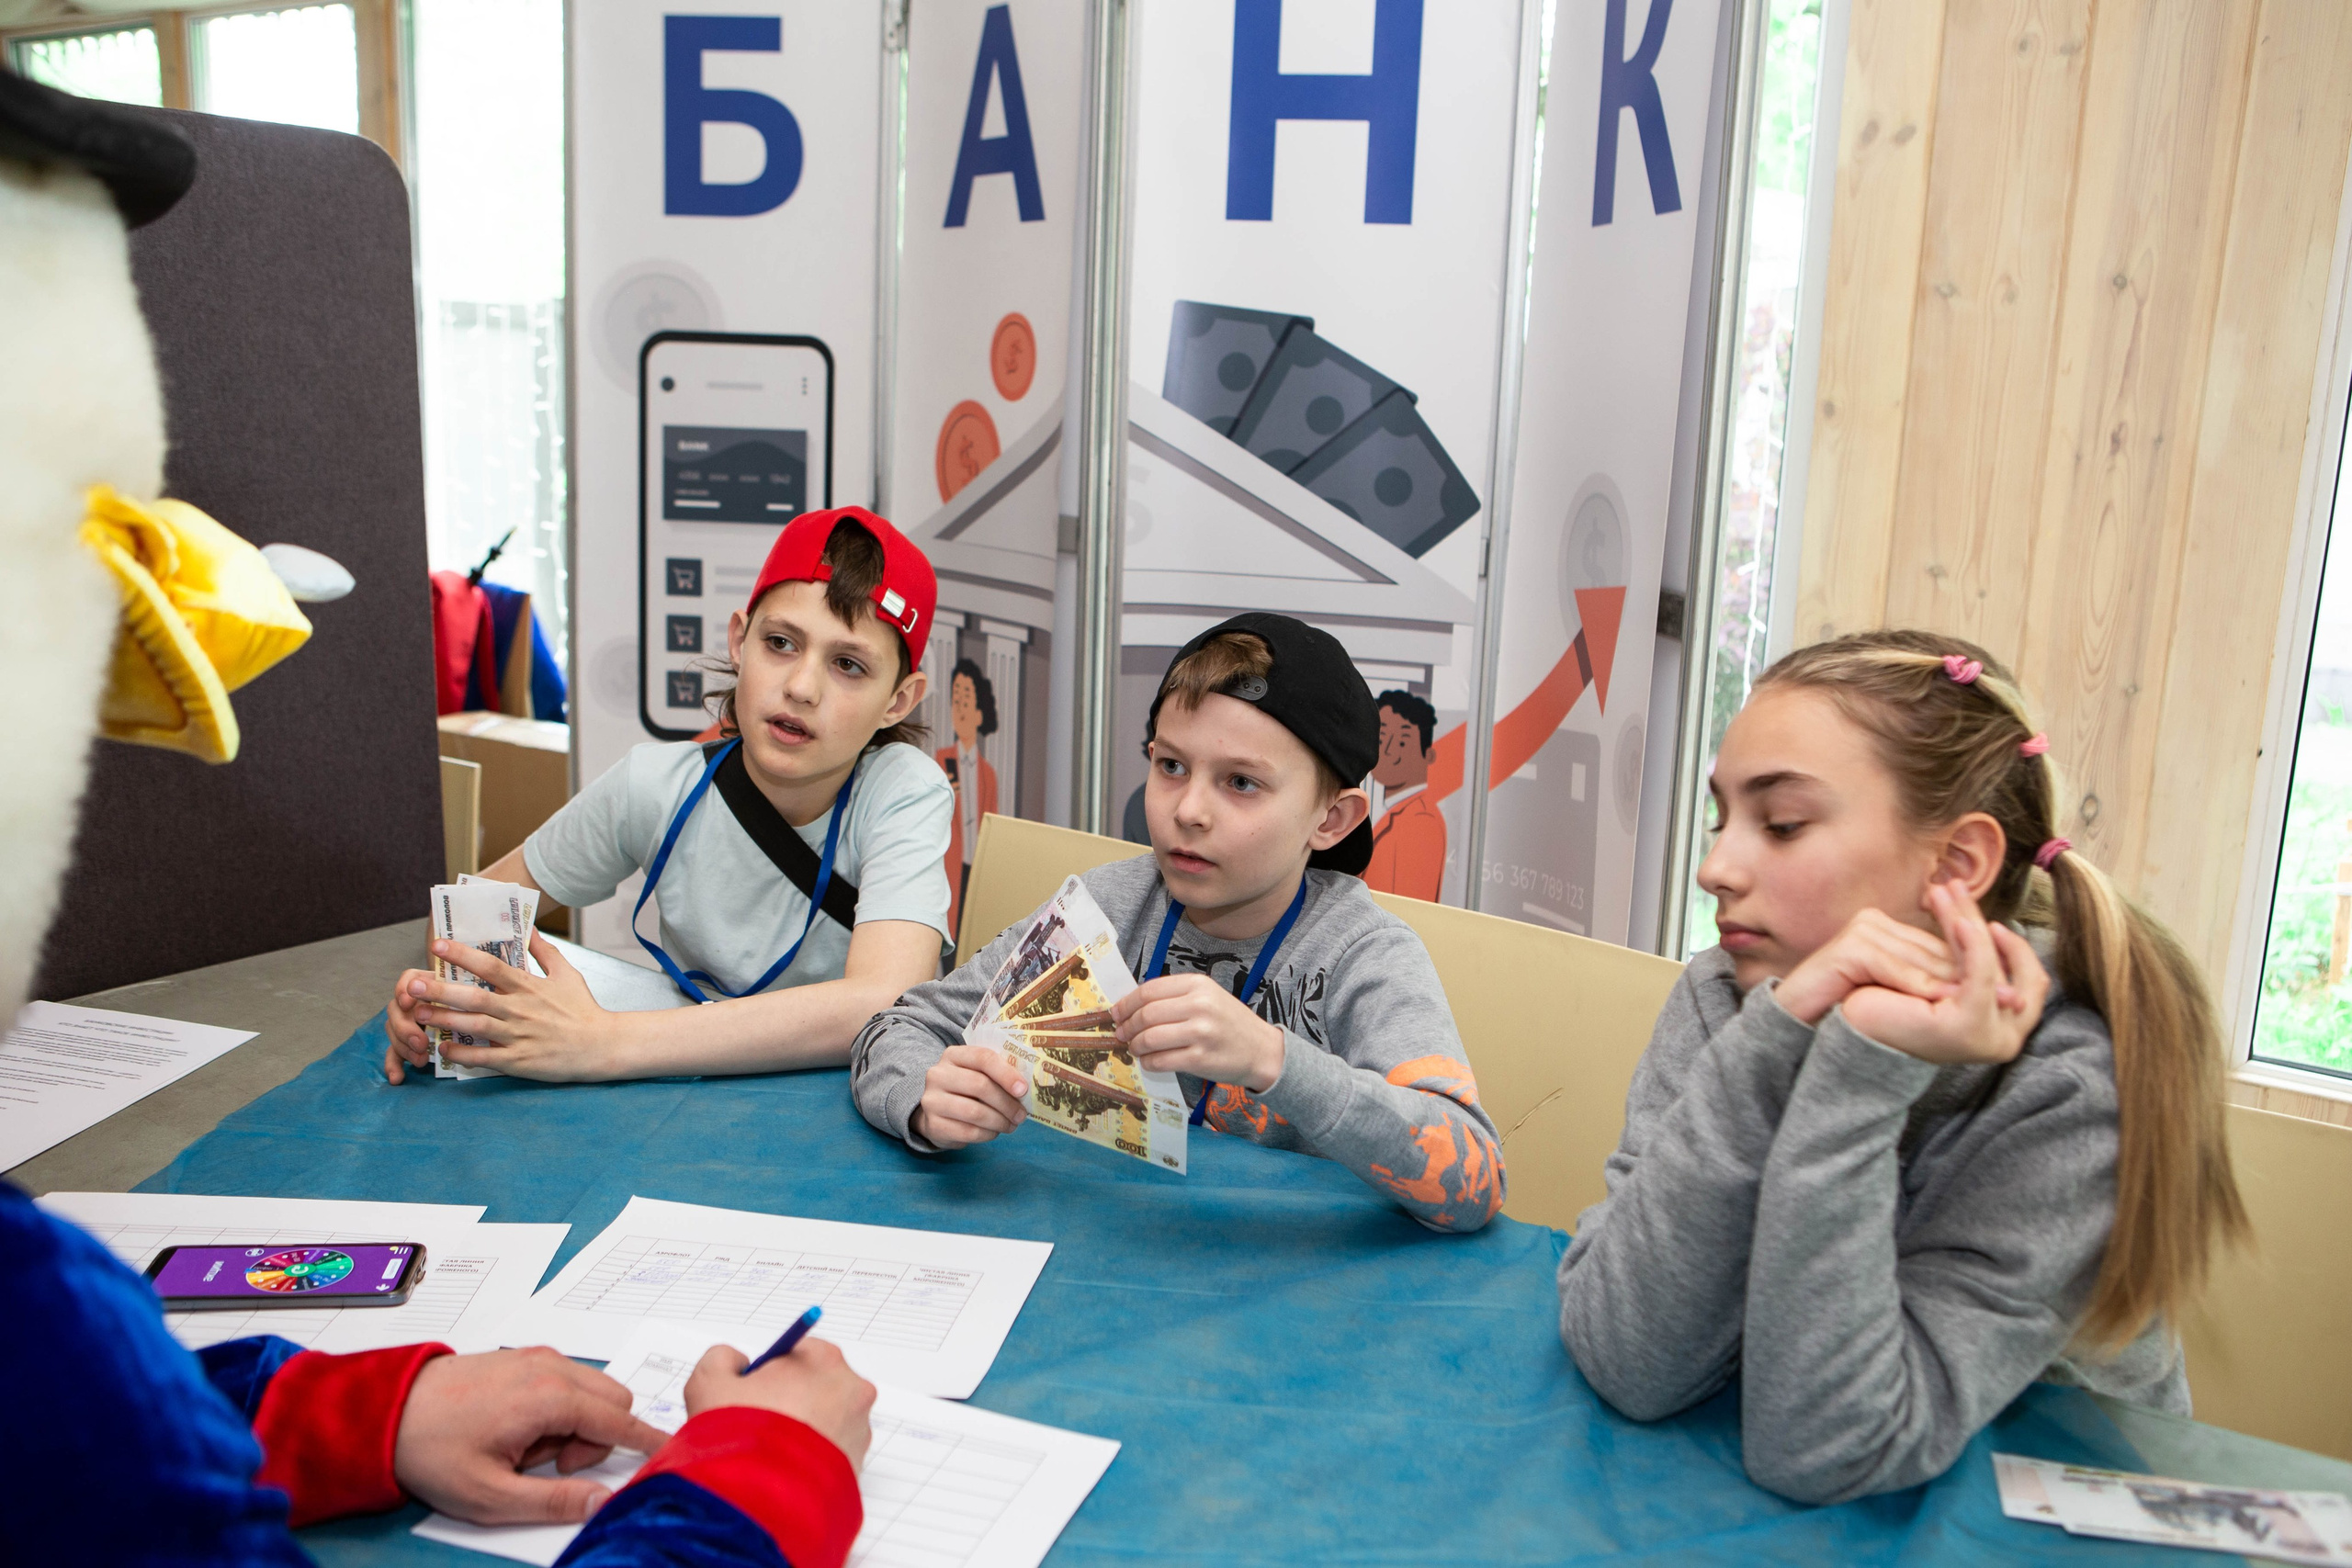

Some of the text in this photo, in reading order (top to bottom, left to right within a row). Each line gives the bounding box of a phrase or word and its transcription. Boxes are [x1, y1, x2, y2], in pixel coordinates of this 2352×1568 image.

[1510, 865, 1537, 888] 367
[1541, 874, 1563, 901] 789
[1566, 883, 1585, 910] 123
[443, 895, 453, 931] ПРИКОЛОВ
[1029, 1035, 1046, 1044] СТО
[1115, 1136, 1148, 1157] 100
[655, 1250, 691, 1258] АЭРОФЛОТ
[795, 1264, 828, 1272] ДЕТСКИЙ
